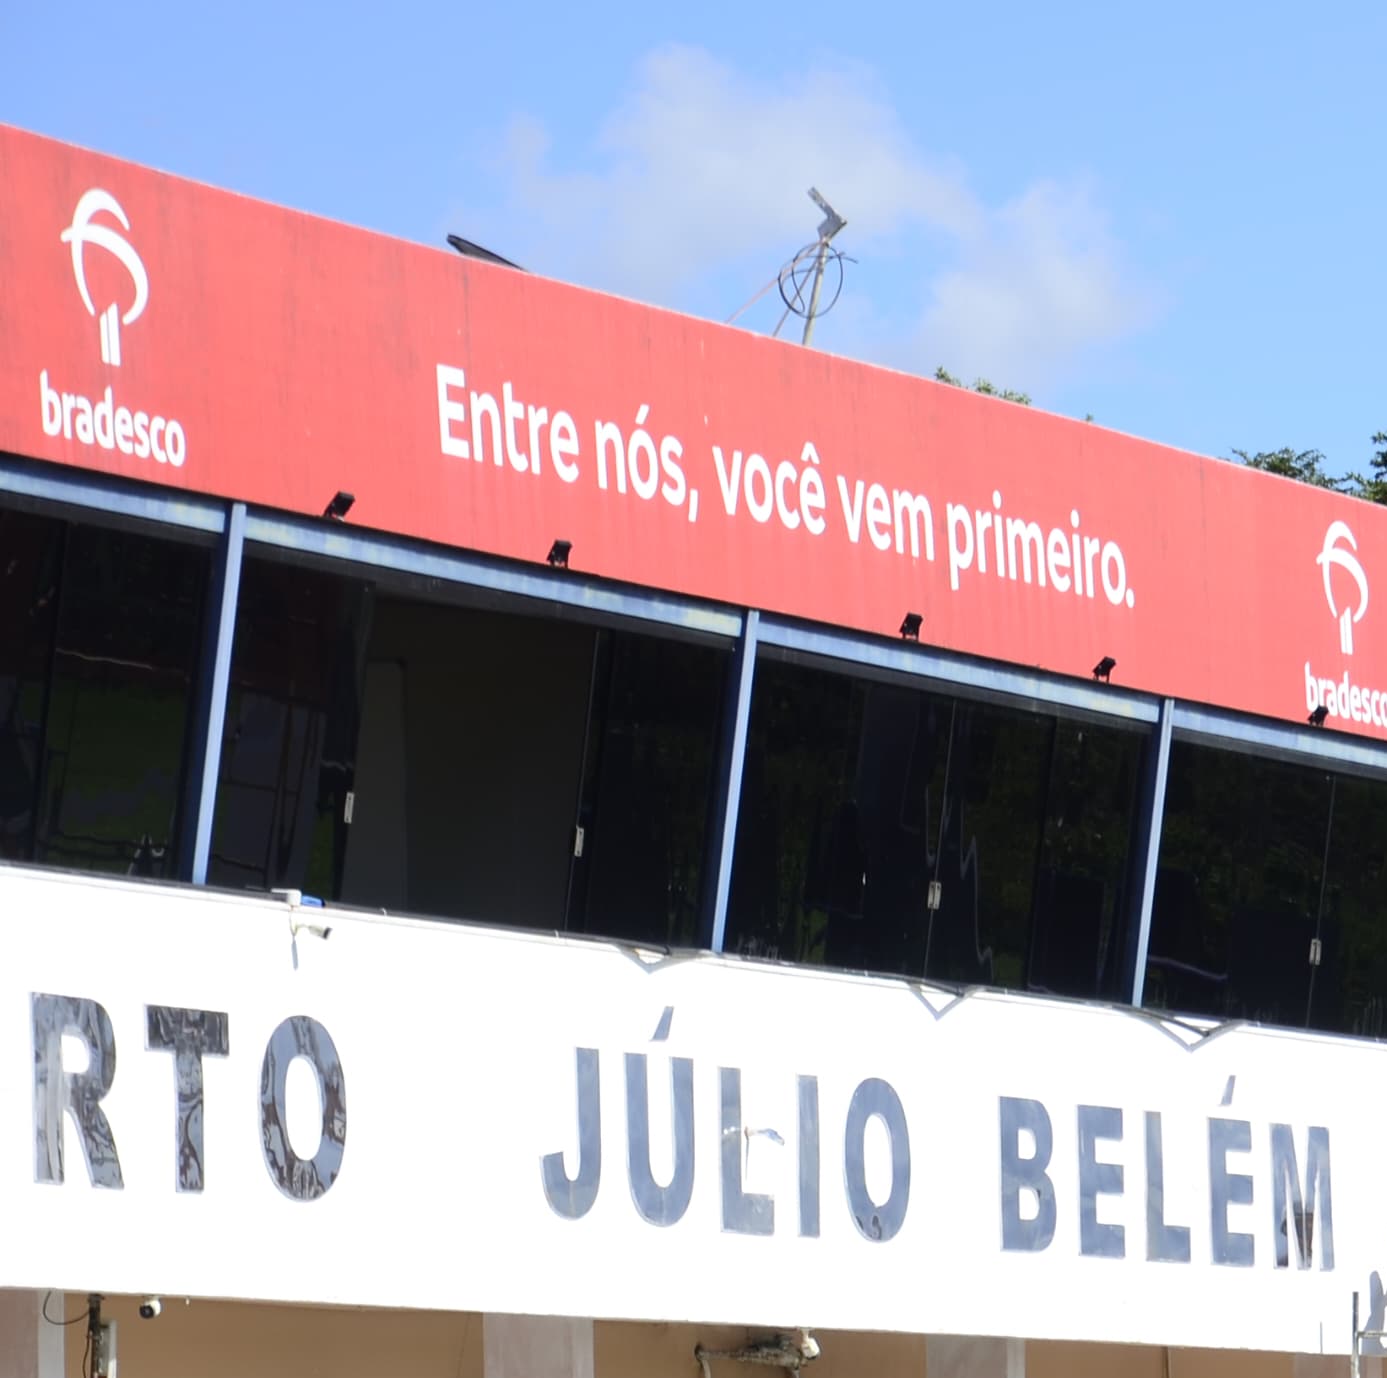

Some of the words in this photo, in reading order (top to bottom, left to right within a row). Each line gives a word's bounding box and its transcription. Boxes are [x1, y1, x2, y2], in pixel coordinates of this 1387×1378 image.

[39, 368, 187, 468] bradesco
[435, 361, 581, 484] Entre
[593, 403, 700, 524] nós,
[711, 441, 827, 538] você
[835, 473, 936, 563] vem
[945, 490, 1137, 614] primeiro.
[30, 990, 349, 1203] RTO
[539, 1005, 913, 1244] JÚLIO
[999, 1074, 1336, 1272] BELÉM
